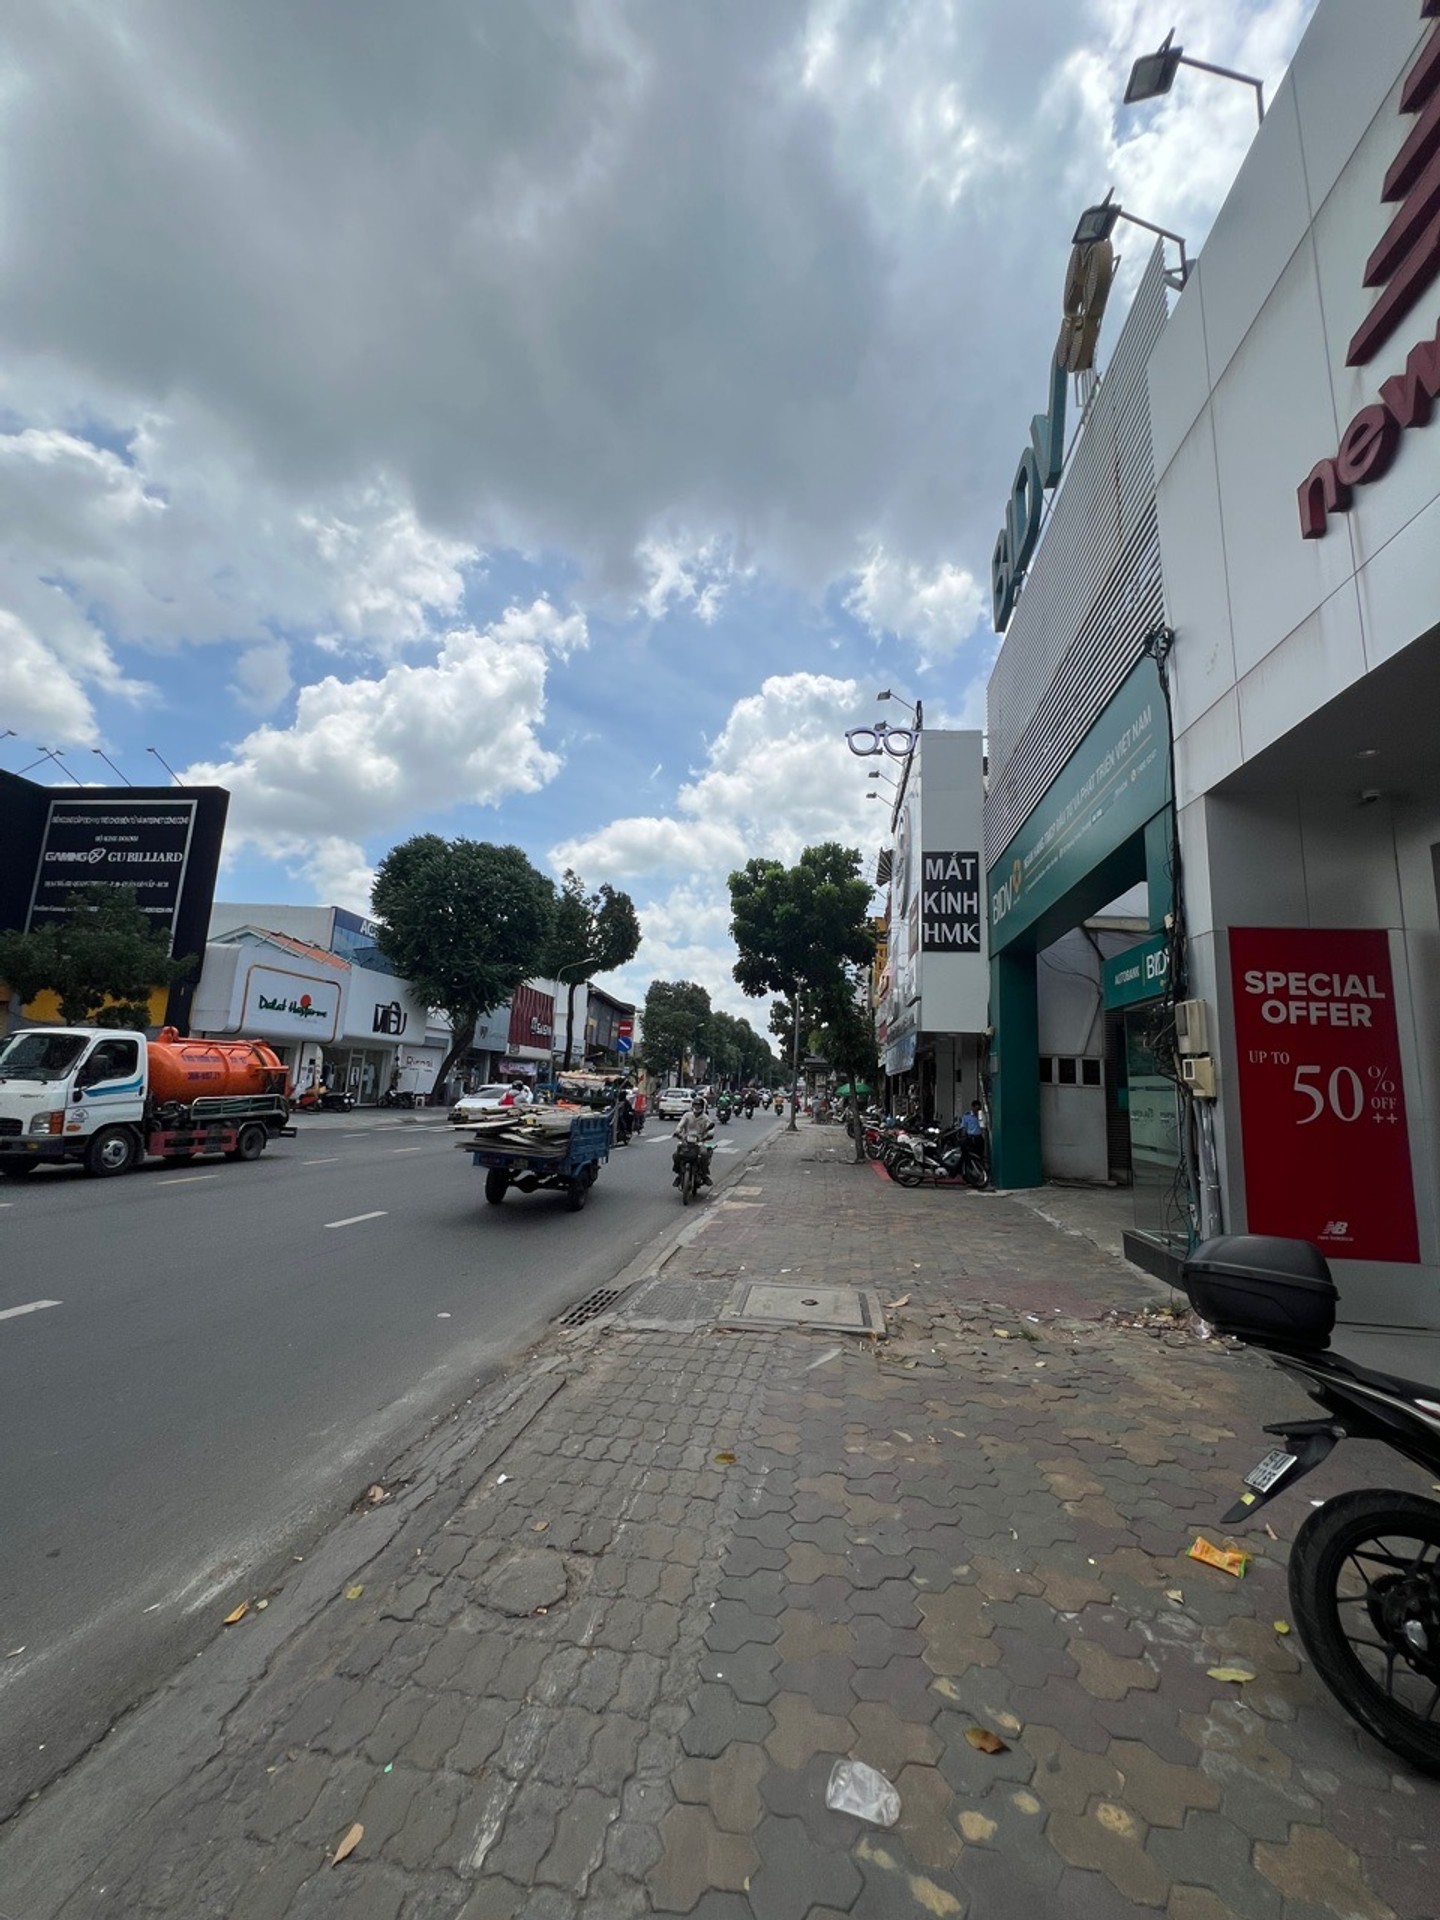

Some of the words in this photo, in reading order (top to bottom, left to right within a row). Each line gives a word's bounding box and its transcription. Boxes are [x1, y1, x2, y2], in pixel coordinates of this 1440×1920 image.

[925, 851, 976, 881] MẮT
[924, 885, 978, 914] KÍNH
[922, 922, 980, 945] HMK
[1244, 970, 1386, 999] SPECIAL
[1261, 1000, 1373, 1027] OFFER
[1249, 1051, 1268, 1063] UP
[1271, 1052, 1290, 1064] TO
[1293, 1065, 1364, 1125] 50
[1371, 1097, 1397, 1109] OFF
